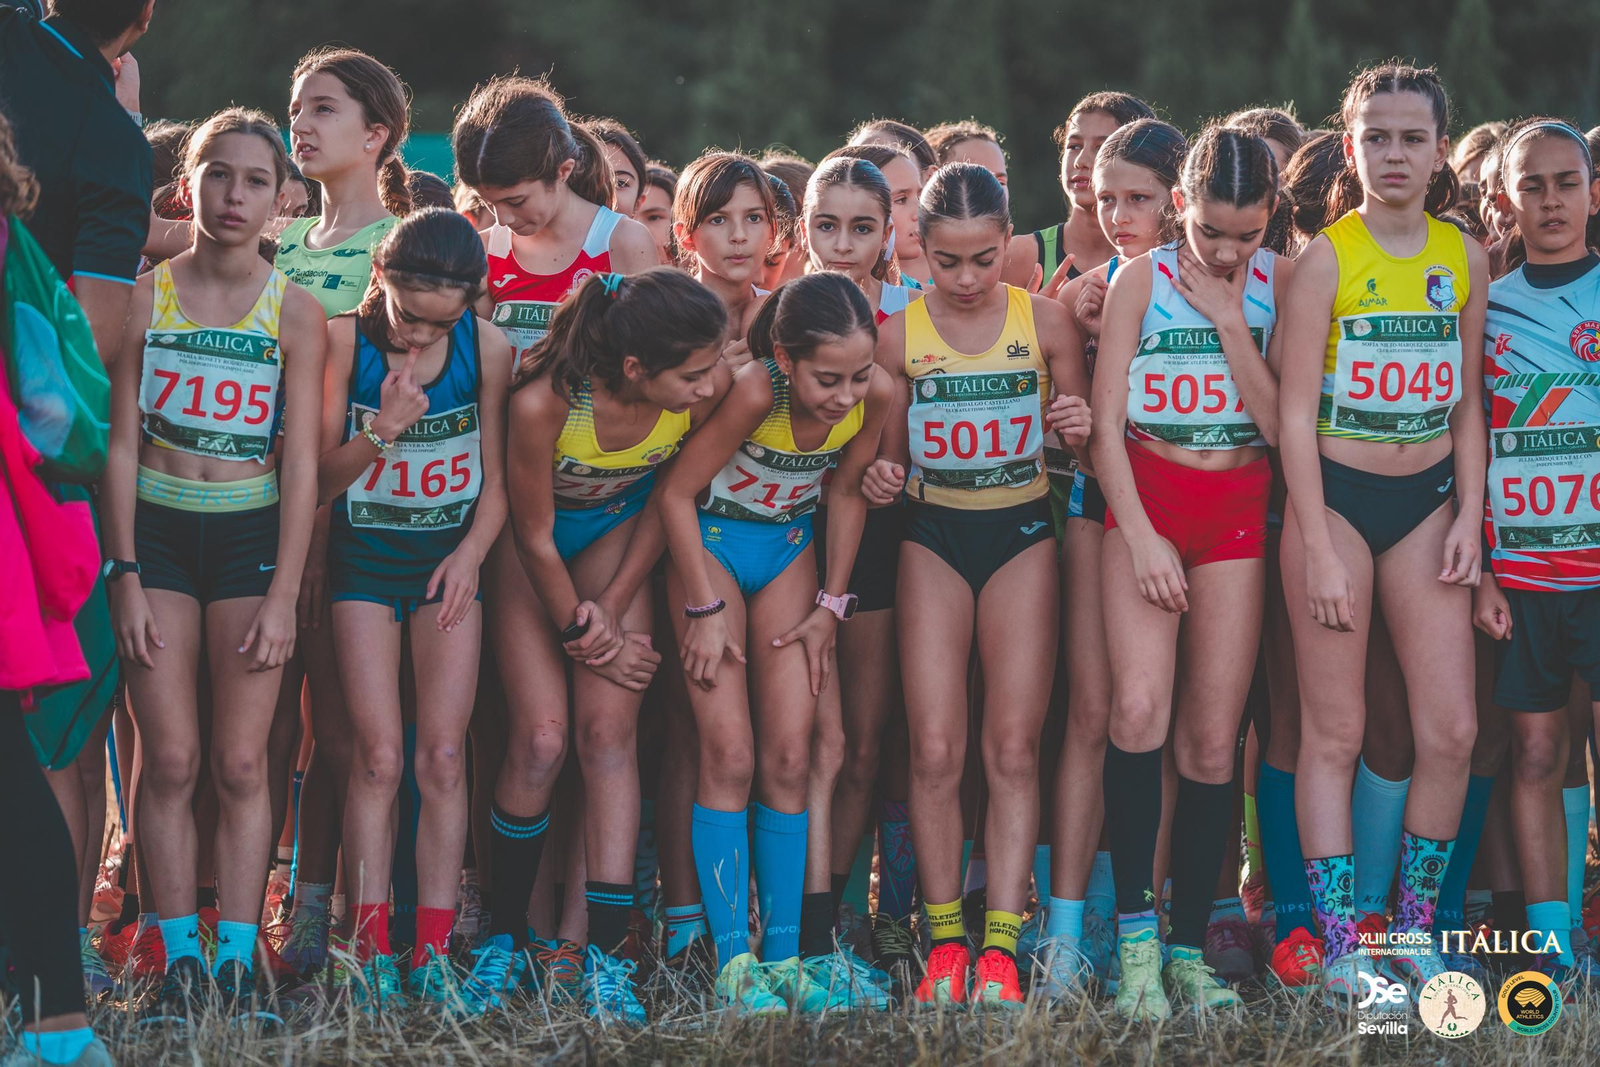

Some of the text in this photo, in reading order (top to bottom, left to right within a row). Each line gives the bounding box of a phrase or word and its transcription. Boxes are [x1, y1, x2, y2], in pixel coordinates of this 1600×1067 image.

[295, 268, 328, 278] Fundación
[517, 305, 552, 322] ITÁLI
[1380, 316, 1437, 333] ITÁLICA
[187, 330, 254, 353] ITÁLICA
[1168, 329, 1220, 346] ITÁLIC
[945, 377, 1010, 394] ITÁLICA
[1348, 361, 1454, 402] 5049
[153, 368, 272, 425] 7195
[984, 398, 1021, 406] CASTELLANO
[1142, 373, 1245, 414] 505
[923, 415, 1033, 460] 5017
[1524, 431, 1587, 448] ITÁLICA
[771, 454, 830, 468] ITÁLICA
[363, 452, 471, 498] 7165
[727, 464, 814, 510] 715
[175, 486, 252, 506] PRO
[928, 910, 961, 920] ATLETISM
[1275, 902, 1312, 914] KIPST
[767, 925, 800, 936] GIVO
